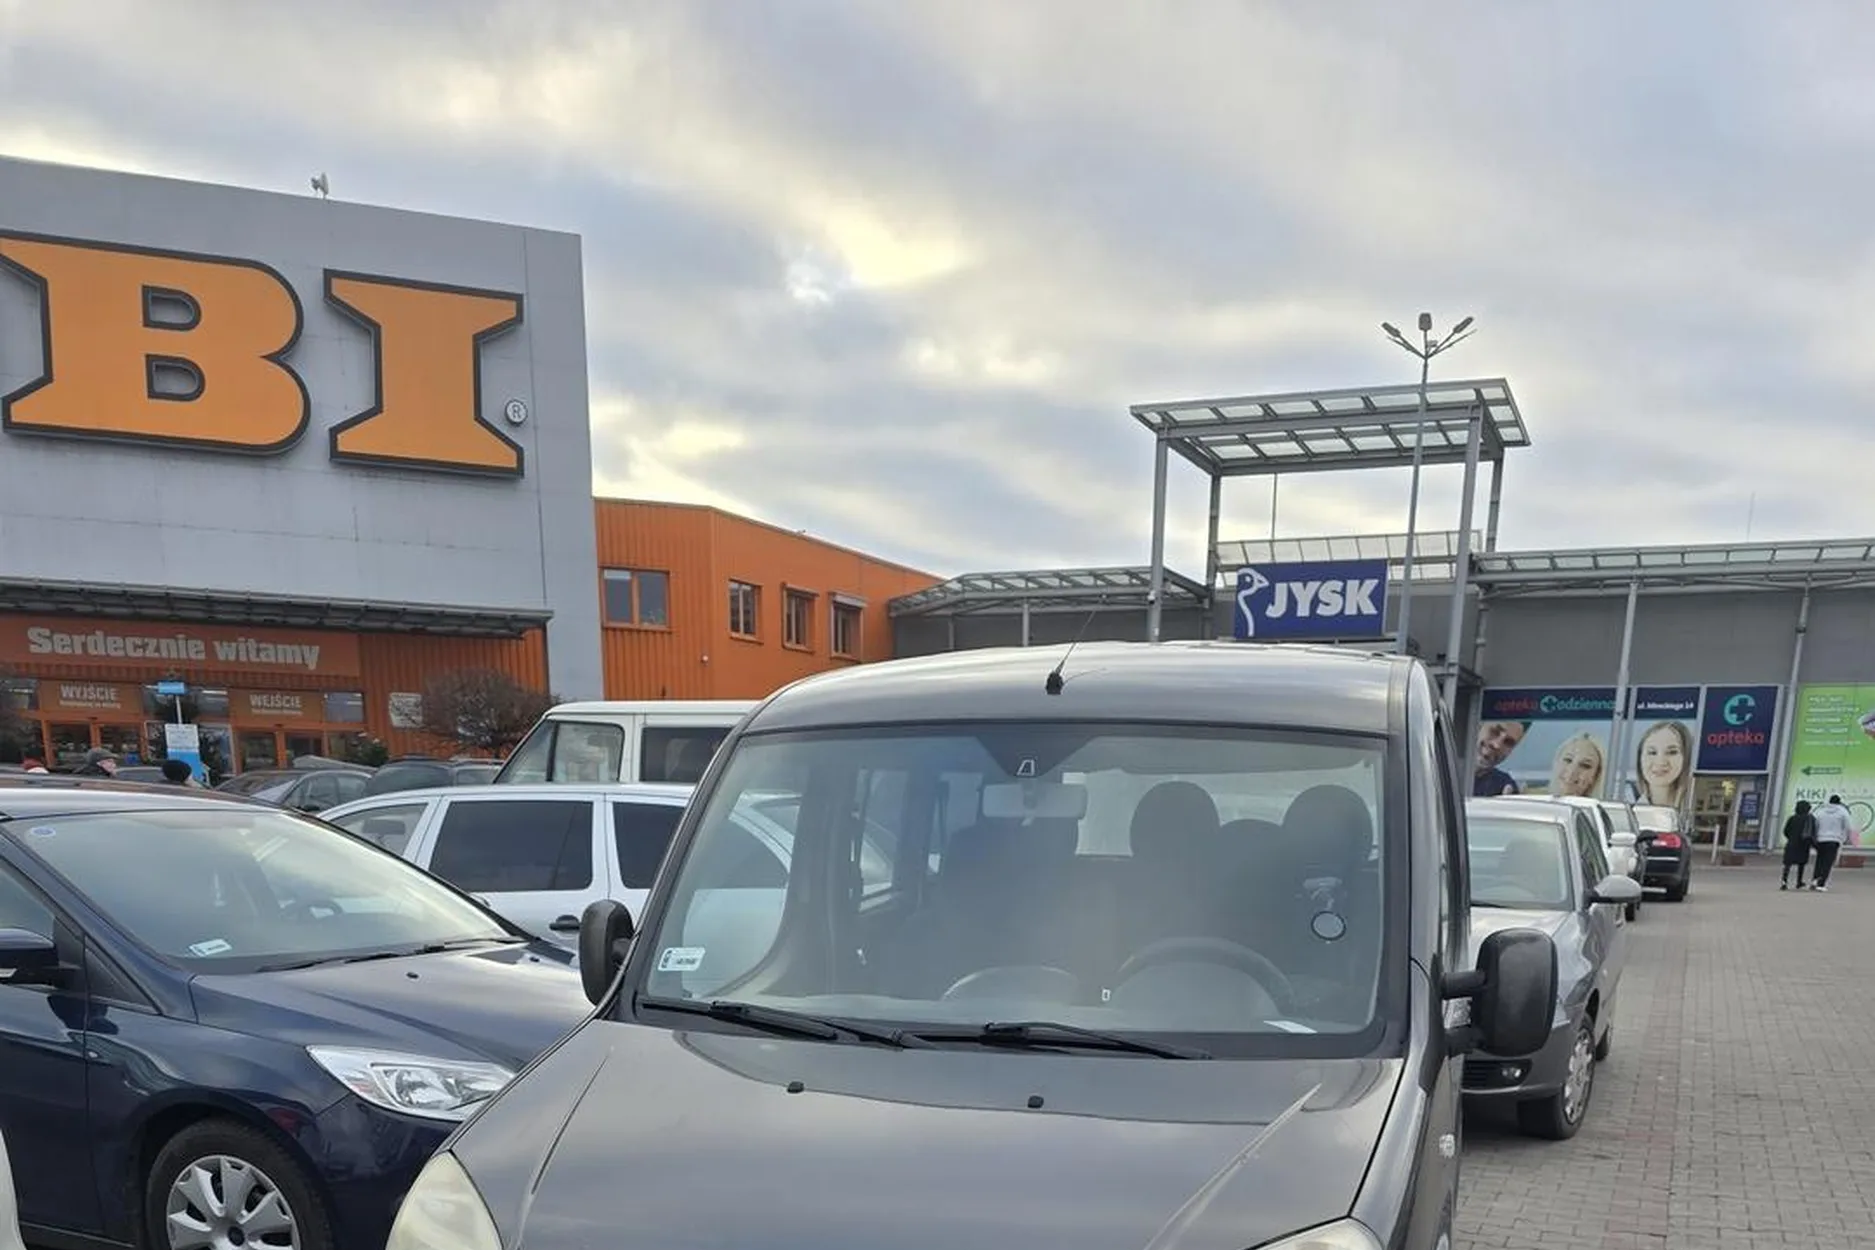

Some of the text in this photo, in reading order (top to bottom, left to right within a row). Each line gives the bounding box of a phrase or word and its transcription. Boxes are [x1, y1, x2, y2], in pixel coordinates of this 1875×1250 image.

[1265, 579, 1380, 618] JYSK
[27, 626, 320, 669] Serdecznie witamy
[1707, 729, 1765, 746] apteka
